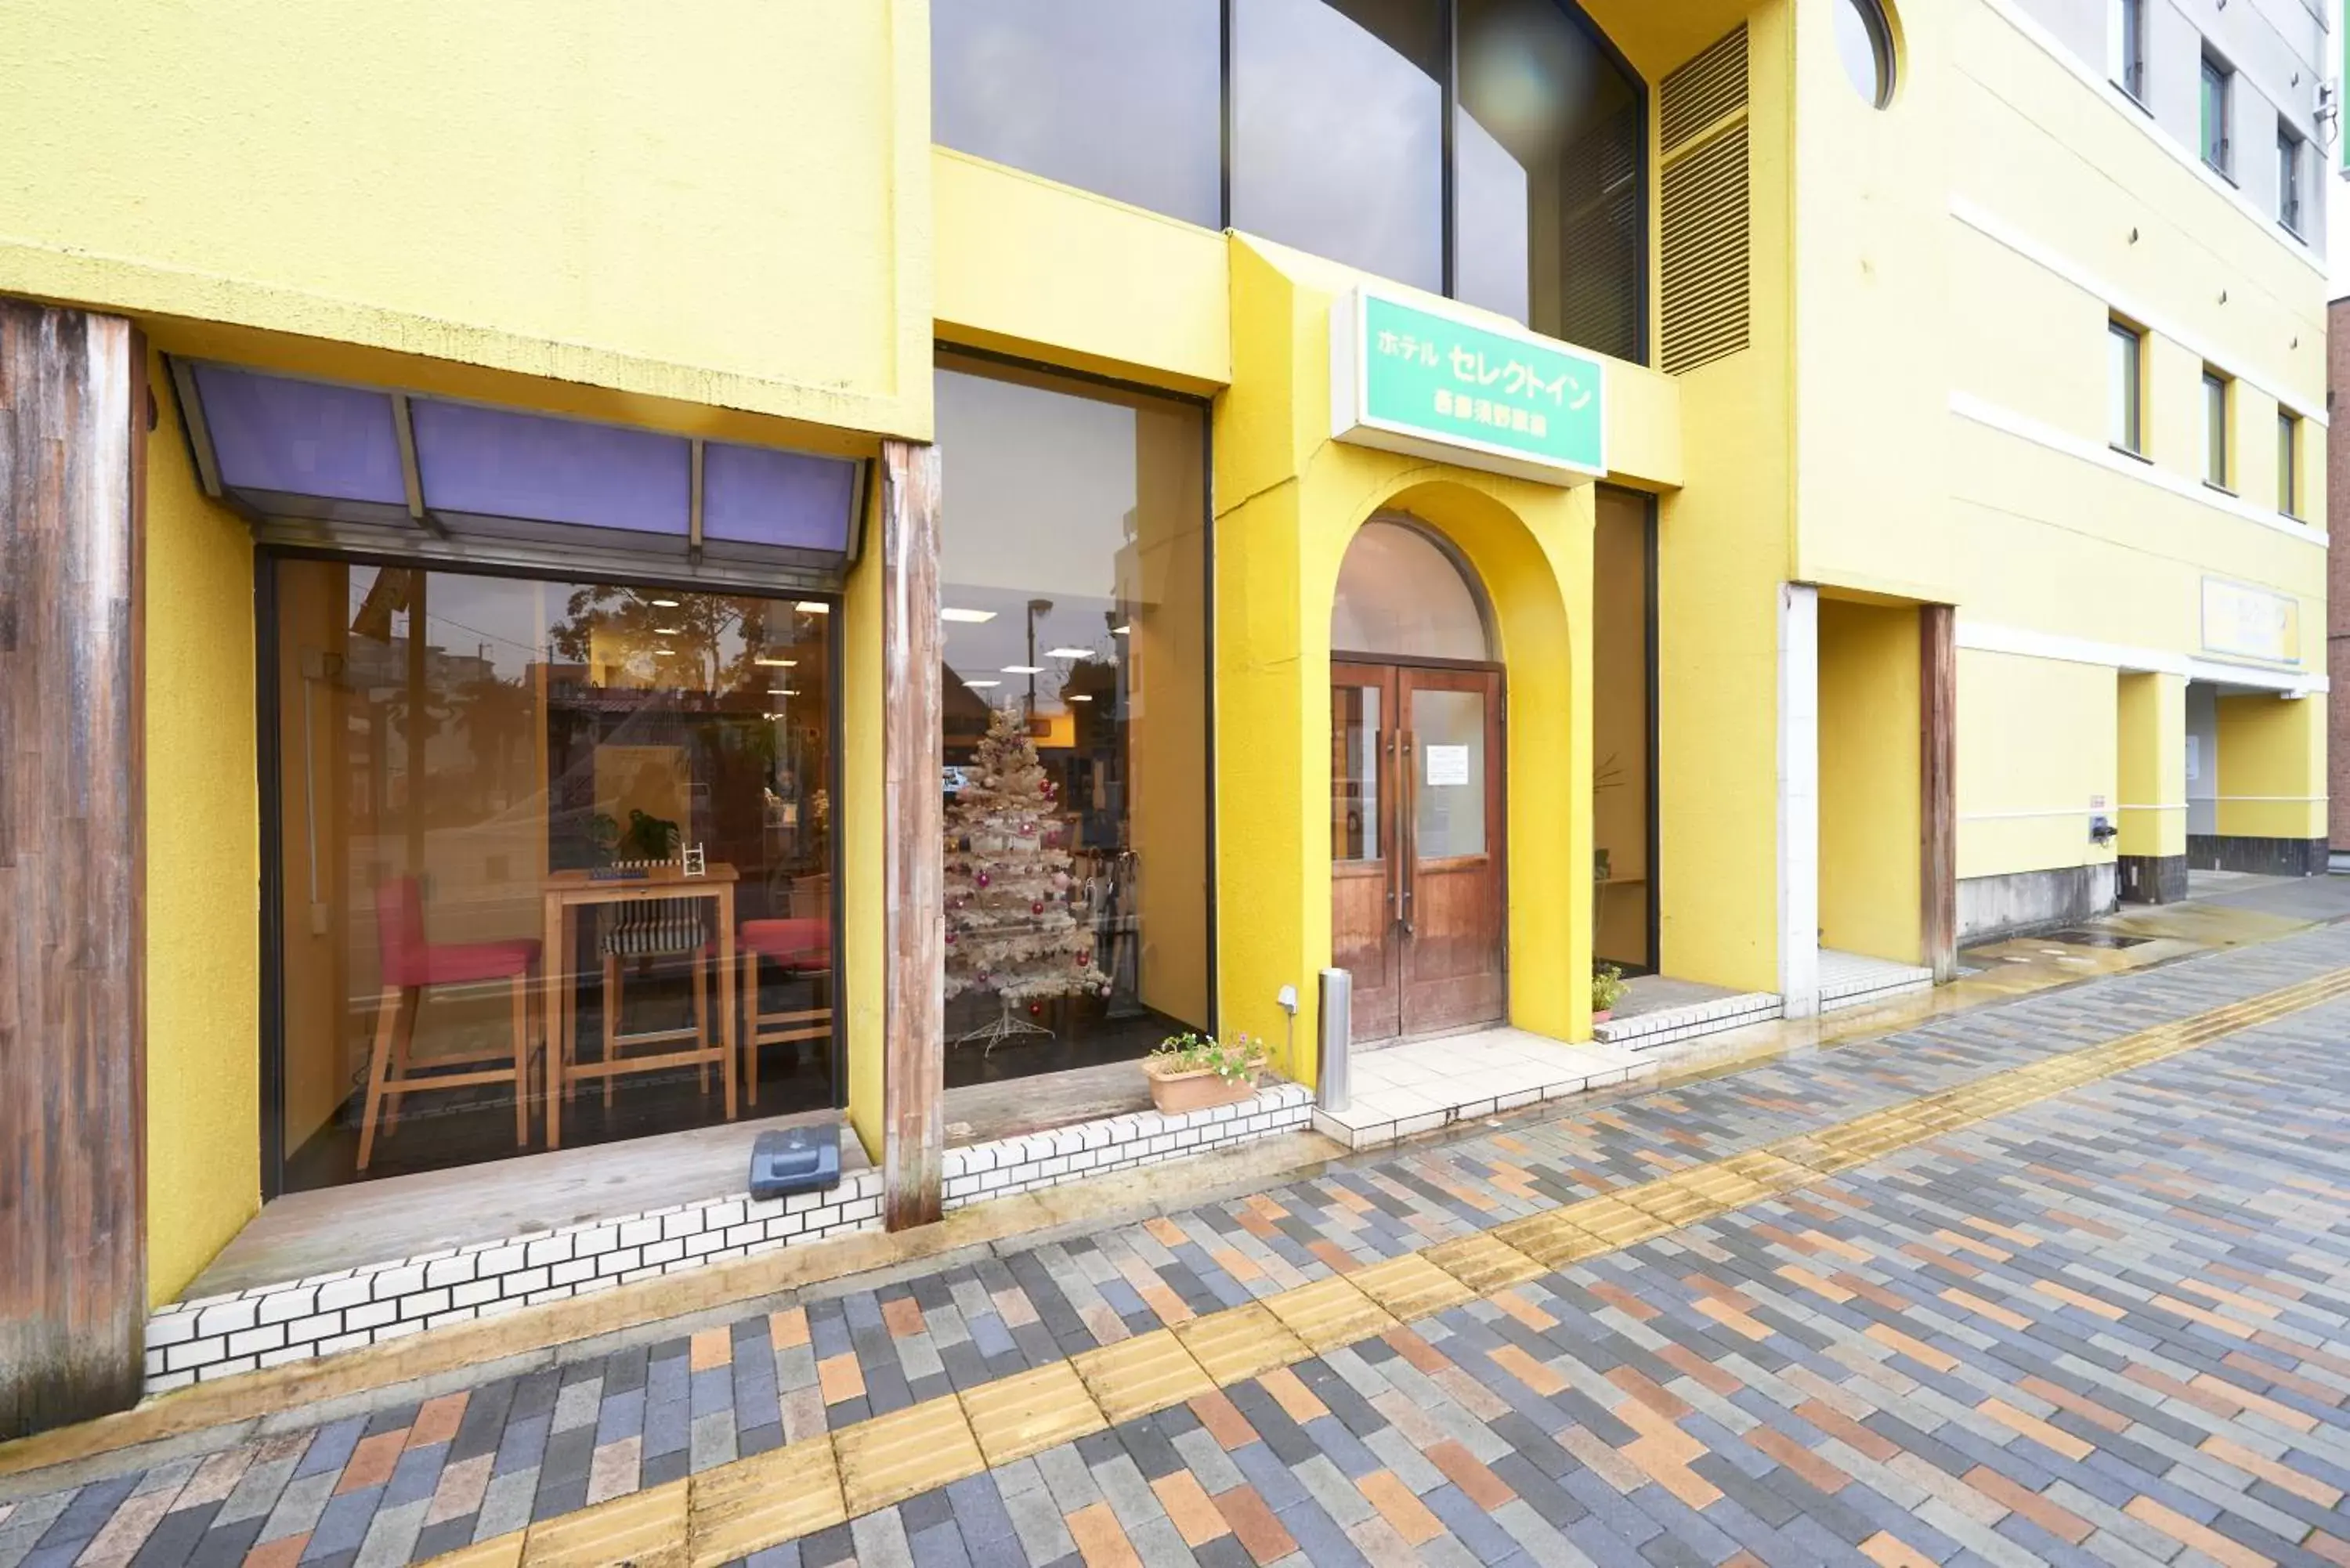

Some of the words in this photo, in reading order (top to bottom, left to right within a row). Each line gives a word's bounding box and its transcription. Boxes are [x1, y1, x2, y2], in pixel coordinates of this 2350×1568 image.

[1379, 331, 1438, 367] ホテル
[1449, 345, 1591, 410] セレクトイン
